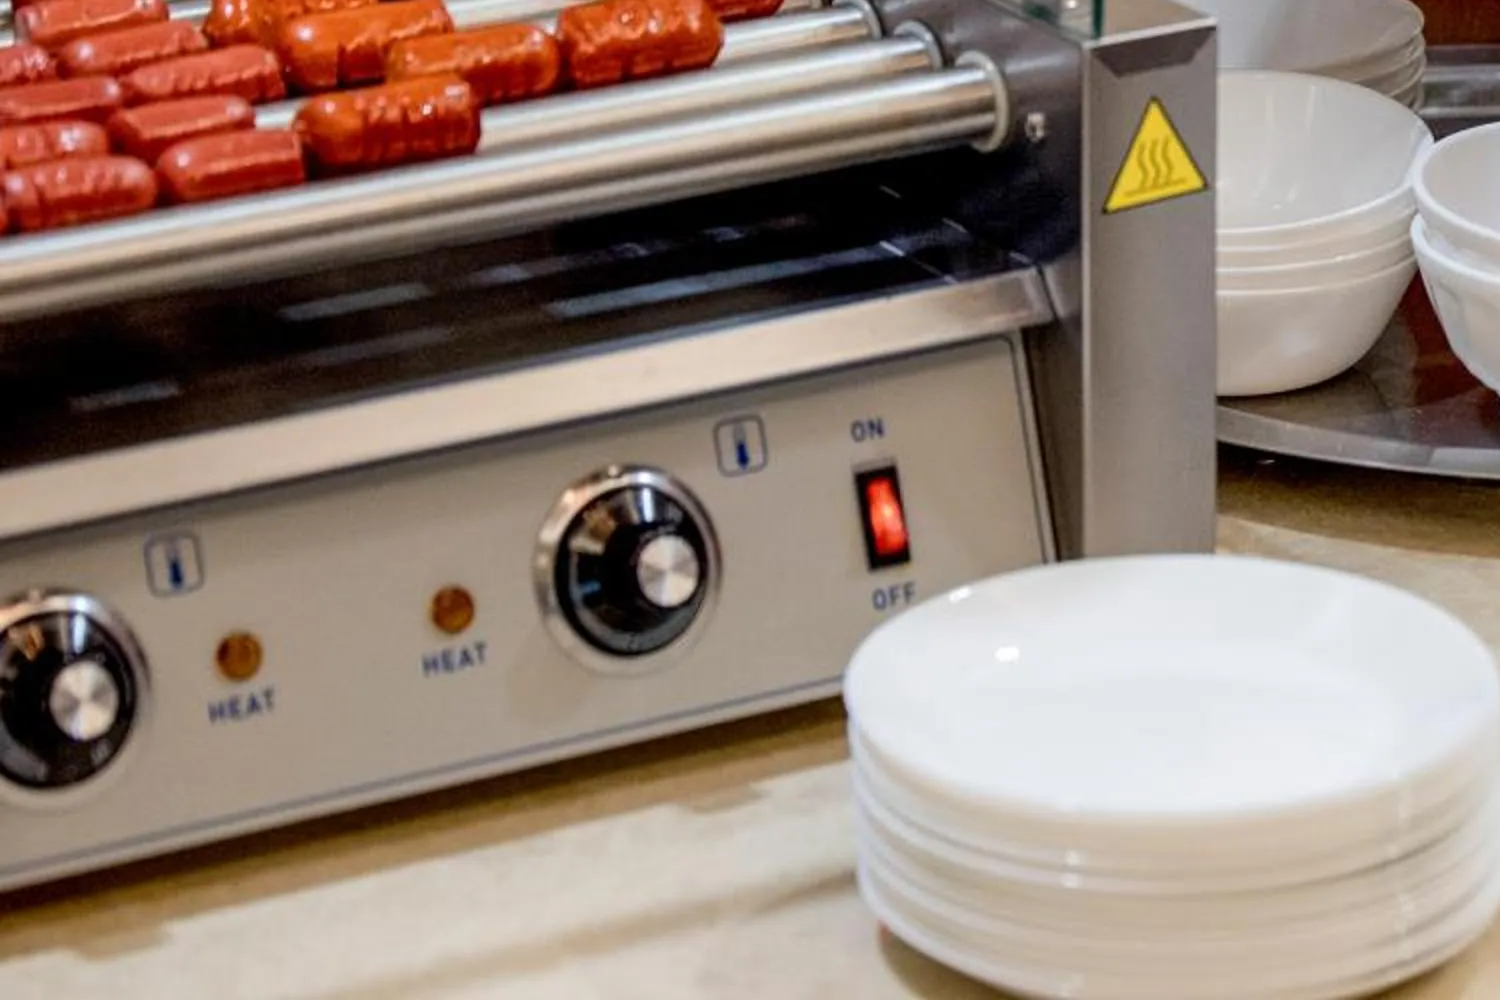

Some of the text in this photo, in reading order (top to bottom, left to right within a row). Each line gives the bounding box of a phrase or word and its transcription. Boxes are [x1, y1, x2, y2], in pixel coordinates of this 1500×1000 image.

[850, 417, 886, 443] ON
[872, 580, 915, 611] OFF
[421, 641, 487, 677] HEAT
[207, 686, 276, 724] HEAT
